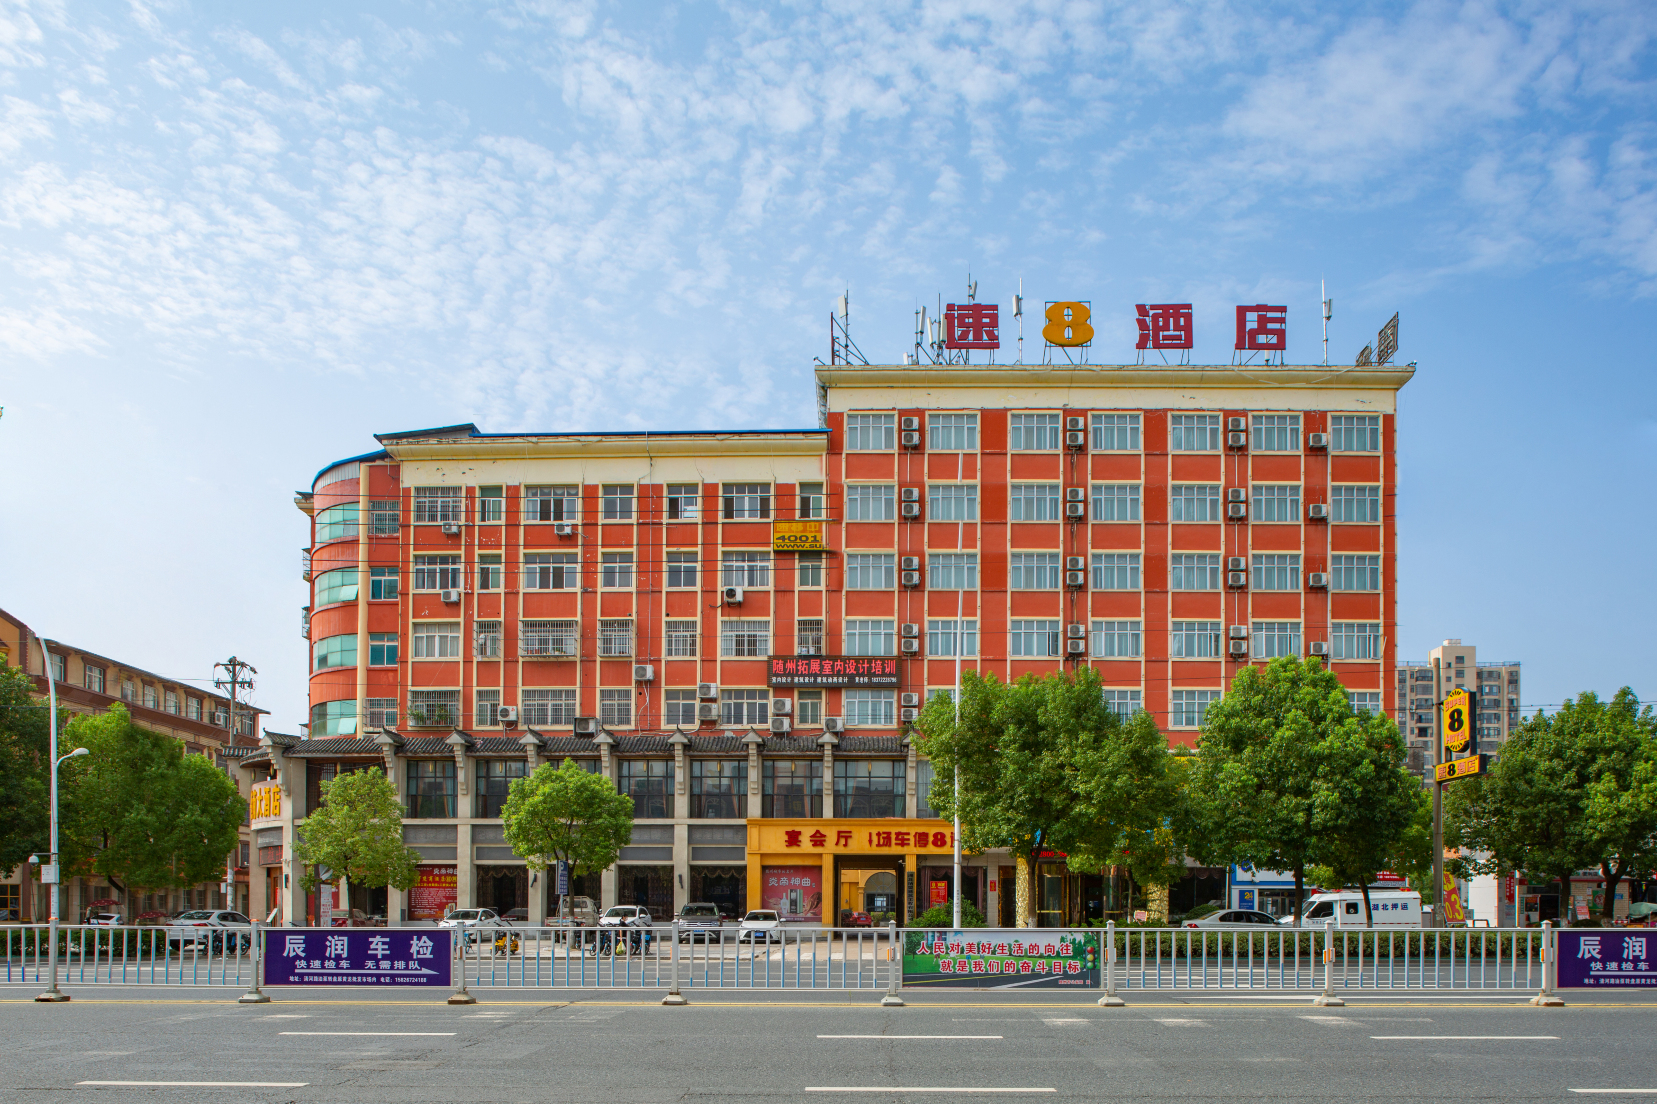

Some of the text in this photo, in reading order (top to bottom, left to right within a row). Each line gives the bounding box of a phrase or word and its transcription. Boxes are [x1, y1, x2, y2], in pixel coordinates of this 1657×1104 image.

[772, 659, 896, 675] 随州拓展室内设计培训
[1445, 695, 1466, 712] SUPER
[1448, 708, 1464, 732] 8
[1445, 729, 1466, 745] HOTEL
[1437, 758, 1476, 779] 速8酒店
[785, 829, 852, 847] 宴会厅
[768, 877, 811, 887] 炎帝神曲
[1371, 902, 1409, 911] 湖北押运
[282, 935, 434, 959] 辰润车检
[916, 941, 1073, 955] 人民对美好生活的向往
[1576, 936, 1647, 960] 辰润
[295, 959, 421, 969] 快速检车 无需排队
[939, 960, 1081, 974] 就是我们的奋斗目标
[1589, 961, 1650, 971] 快速检车
